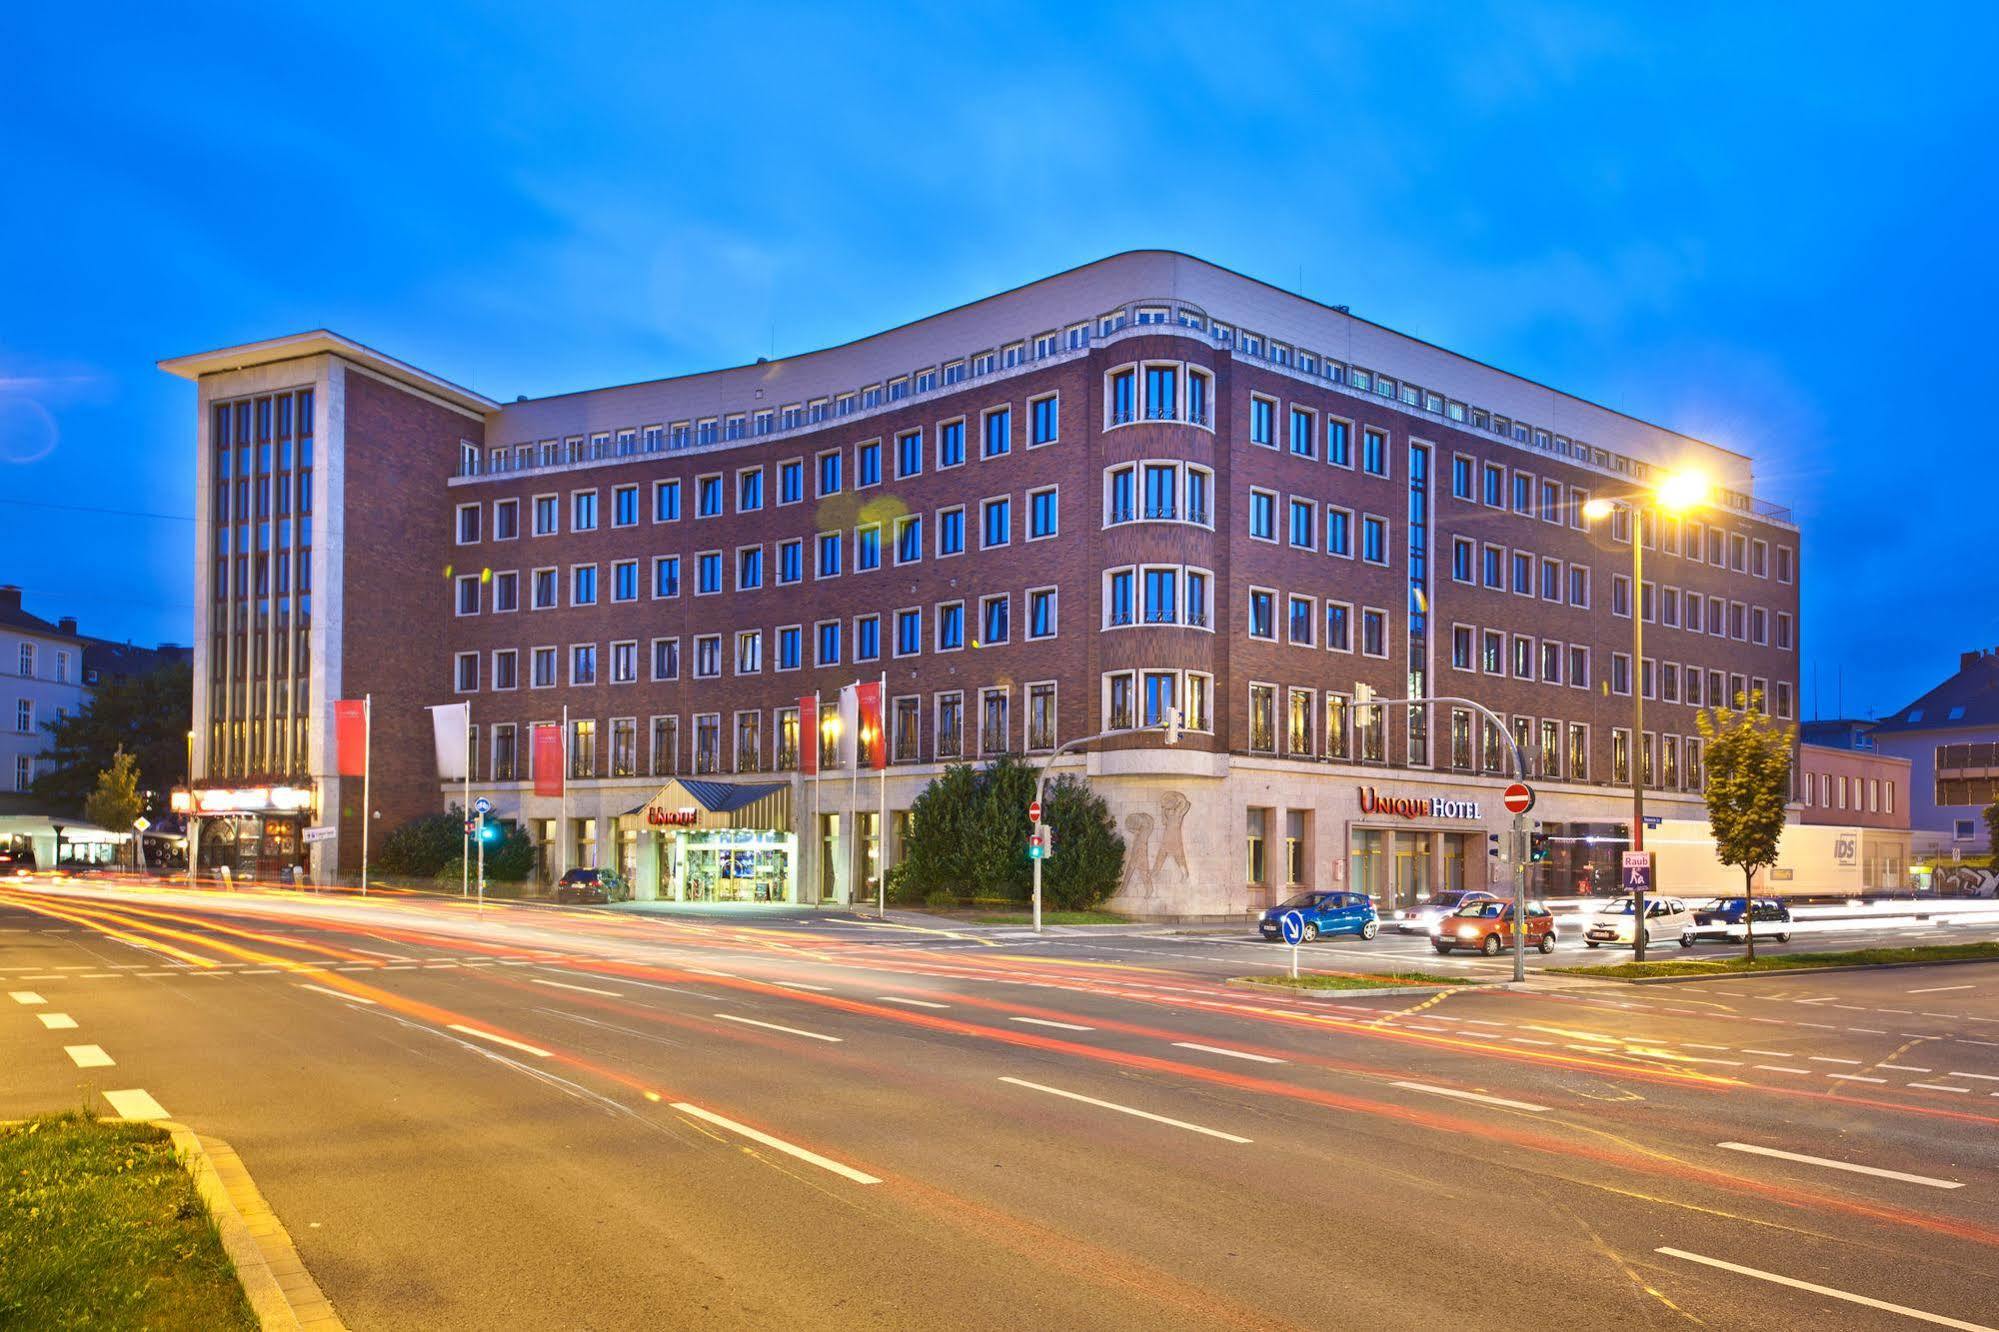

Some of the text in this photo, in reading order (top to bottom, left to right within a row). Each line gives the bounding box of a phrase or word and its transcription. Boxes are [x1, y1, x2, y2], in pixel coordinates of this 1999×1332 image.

[1359, 786, 1481, 820] UNIQUE HOTEL
[1834, 840, 1855, 858] IDS
[1625, 857, 1648, 866] Raub
